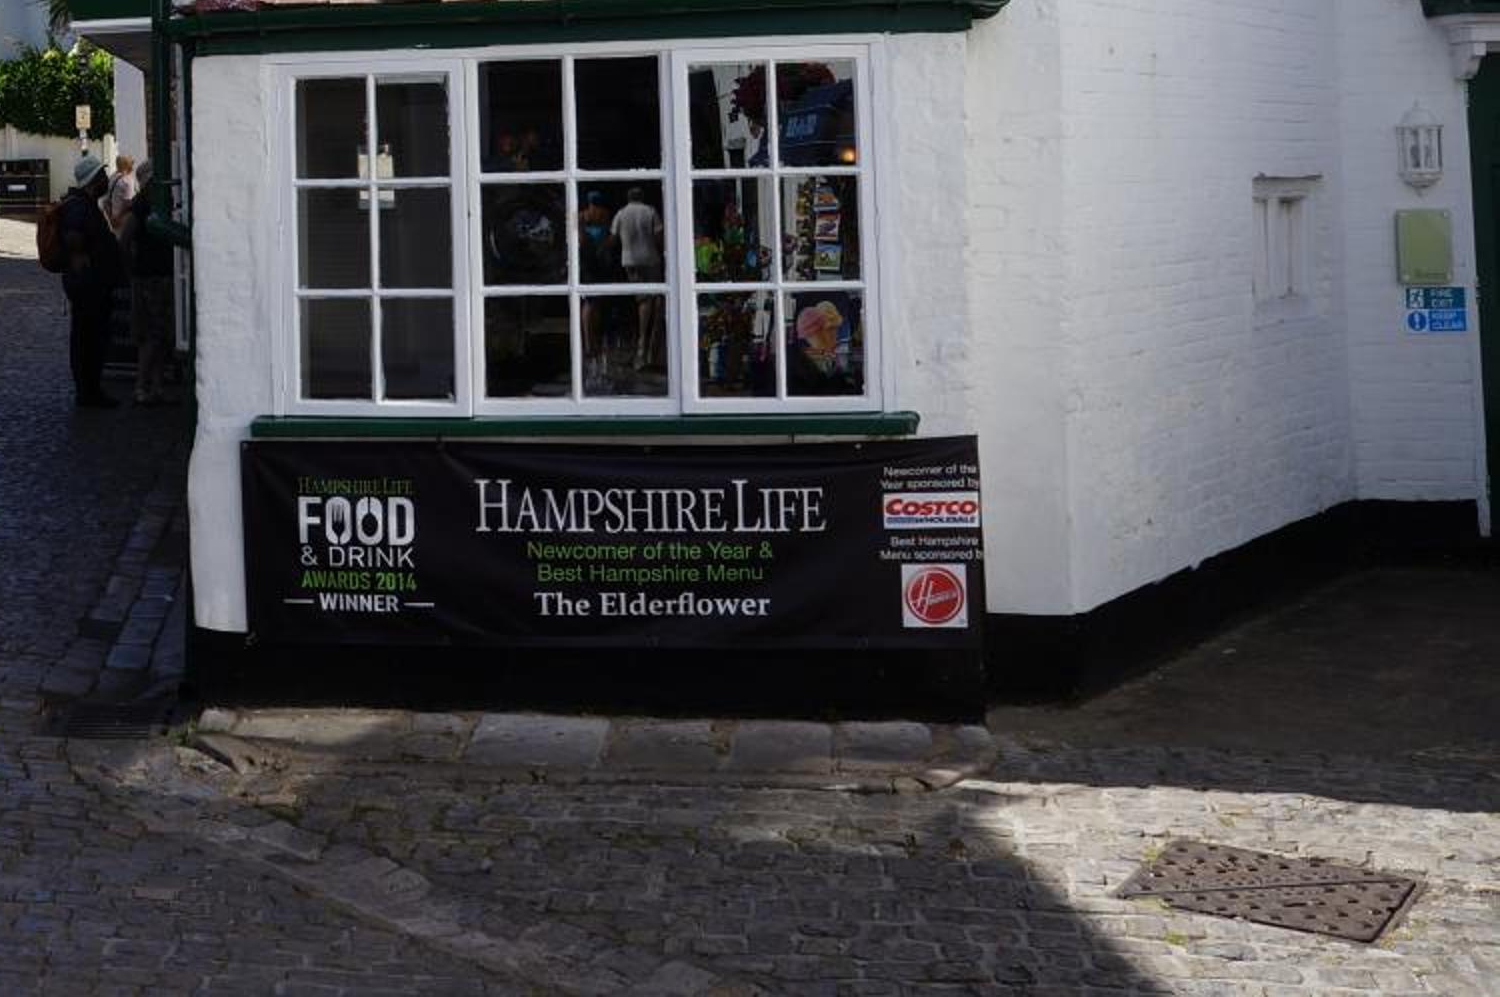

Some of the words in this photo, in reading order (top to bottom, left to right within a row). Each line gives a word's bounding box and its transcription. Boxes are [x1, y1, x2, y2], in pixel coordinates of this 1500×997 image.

[883, 466, 942, 476] Newcomer
[945, 465, 957, 474] of
[960, 464, 977, 474] the
[881, 480, 902, 490] Year
[907, 477, 964, 490] sponsored
[474, 479, 729, 533] HAMPSHIRE
[731, 478, 828, 533] LIFE
[886, 499, 977, 515] COSTCO
[298, 496, 415, 545] FOOD
[527, 542, 636, 560] Newcomer
[643, 541, 664, 560] of
[668, 541, 702, 560] the
[707, 542, 751, 560] Year
[758, 542, 773, 559] &
[891, 536, 916, 547] Best
[919, 536, 978, 548] Hampshire
[301, 545, 318, 566] &
[329, 546, 415, 569] DRINK
[880, 549, 912, 559] Menu
[302, 570, 371, 590] AWARDS
[376, 572, 417, 591] 2014
[538, 564, 582, 582] Best
[590, 563, 700, 586] Hampshire
[707, 564, 763, 582] Menu
[319, 592, 399, 612] WINNER
[534, 593, 590, 616] The
[600, 592, 771, 617] Elderflower
